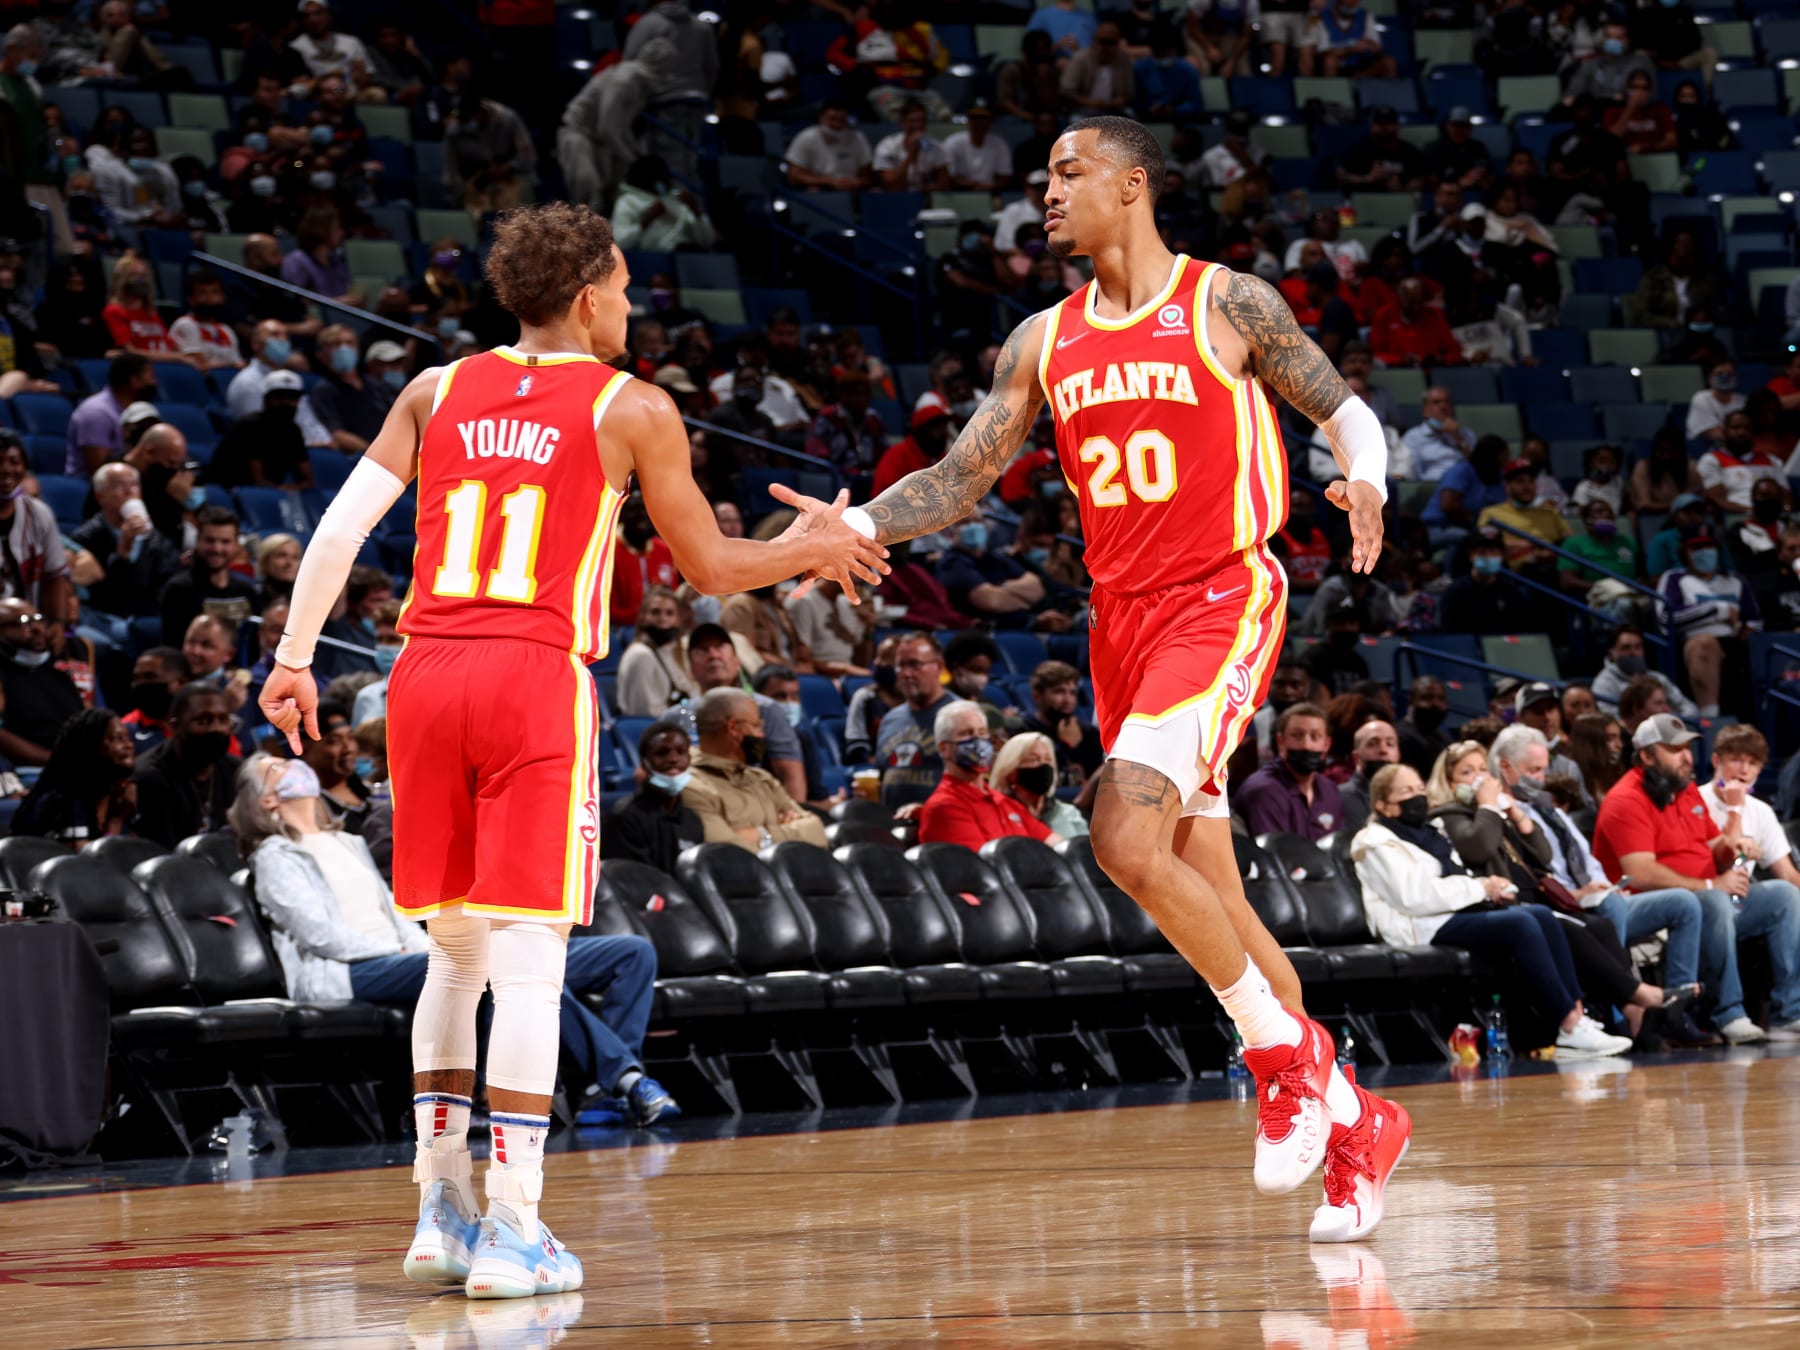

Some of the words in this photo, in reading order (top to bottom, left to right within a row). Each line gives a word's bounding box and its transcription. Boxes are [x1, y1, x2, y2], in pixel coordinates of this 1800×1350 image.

[1152, 329, 1190, 338] sharecare
[1053, 361, 1200, 425] ATLANTA
[456, 418, 561, 465] YOUNG
[1078, 429, 1178, 508] 20
[432, 479, 547, 604] 11
